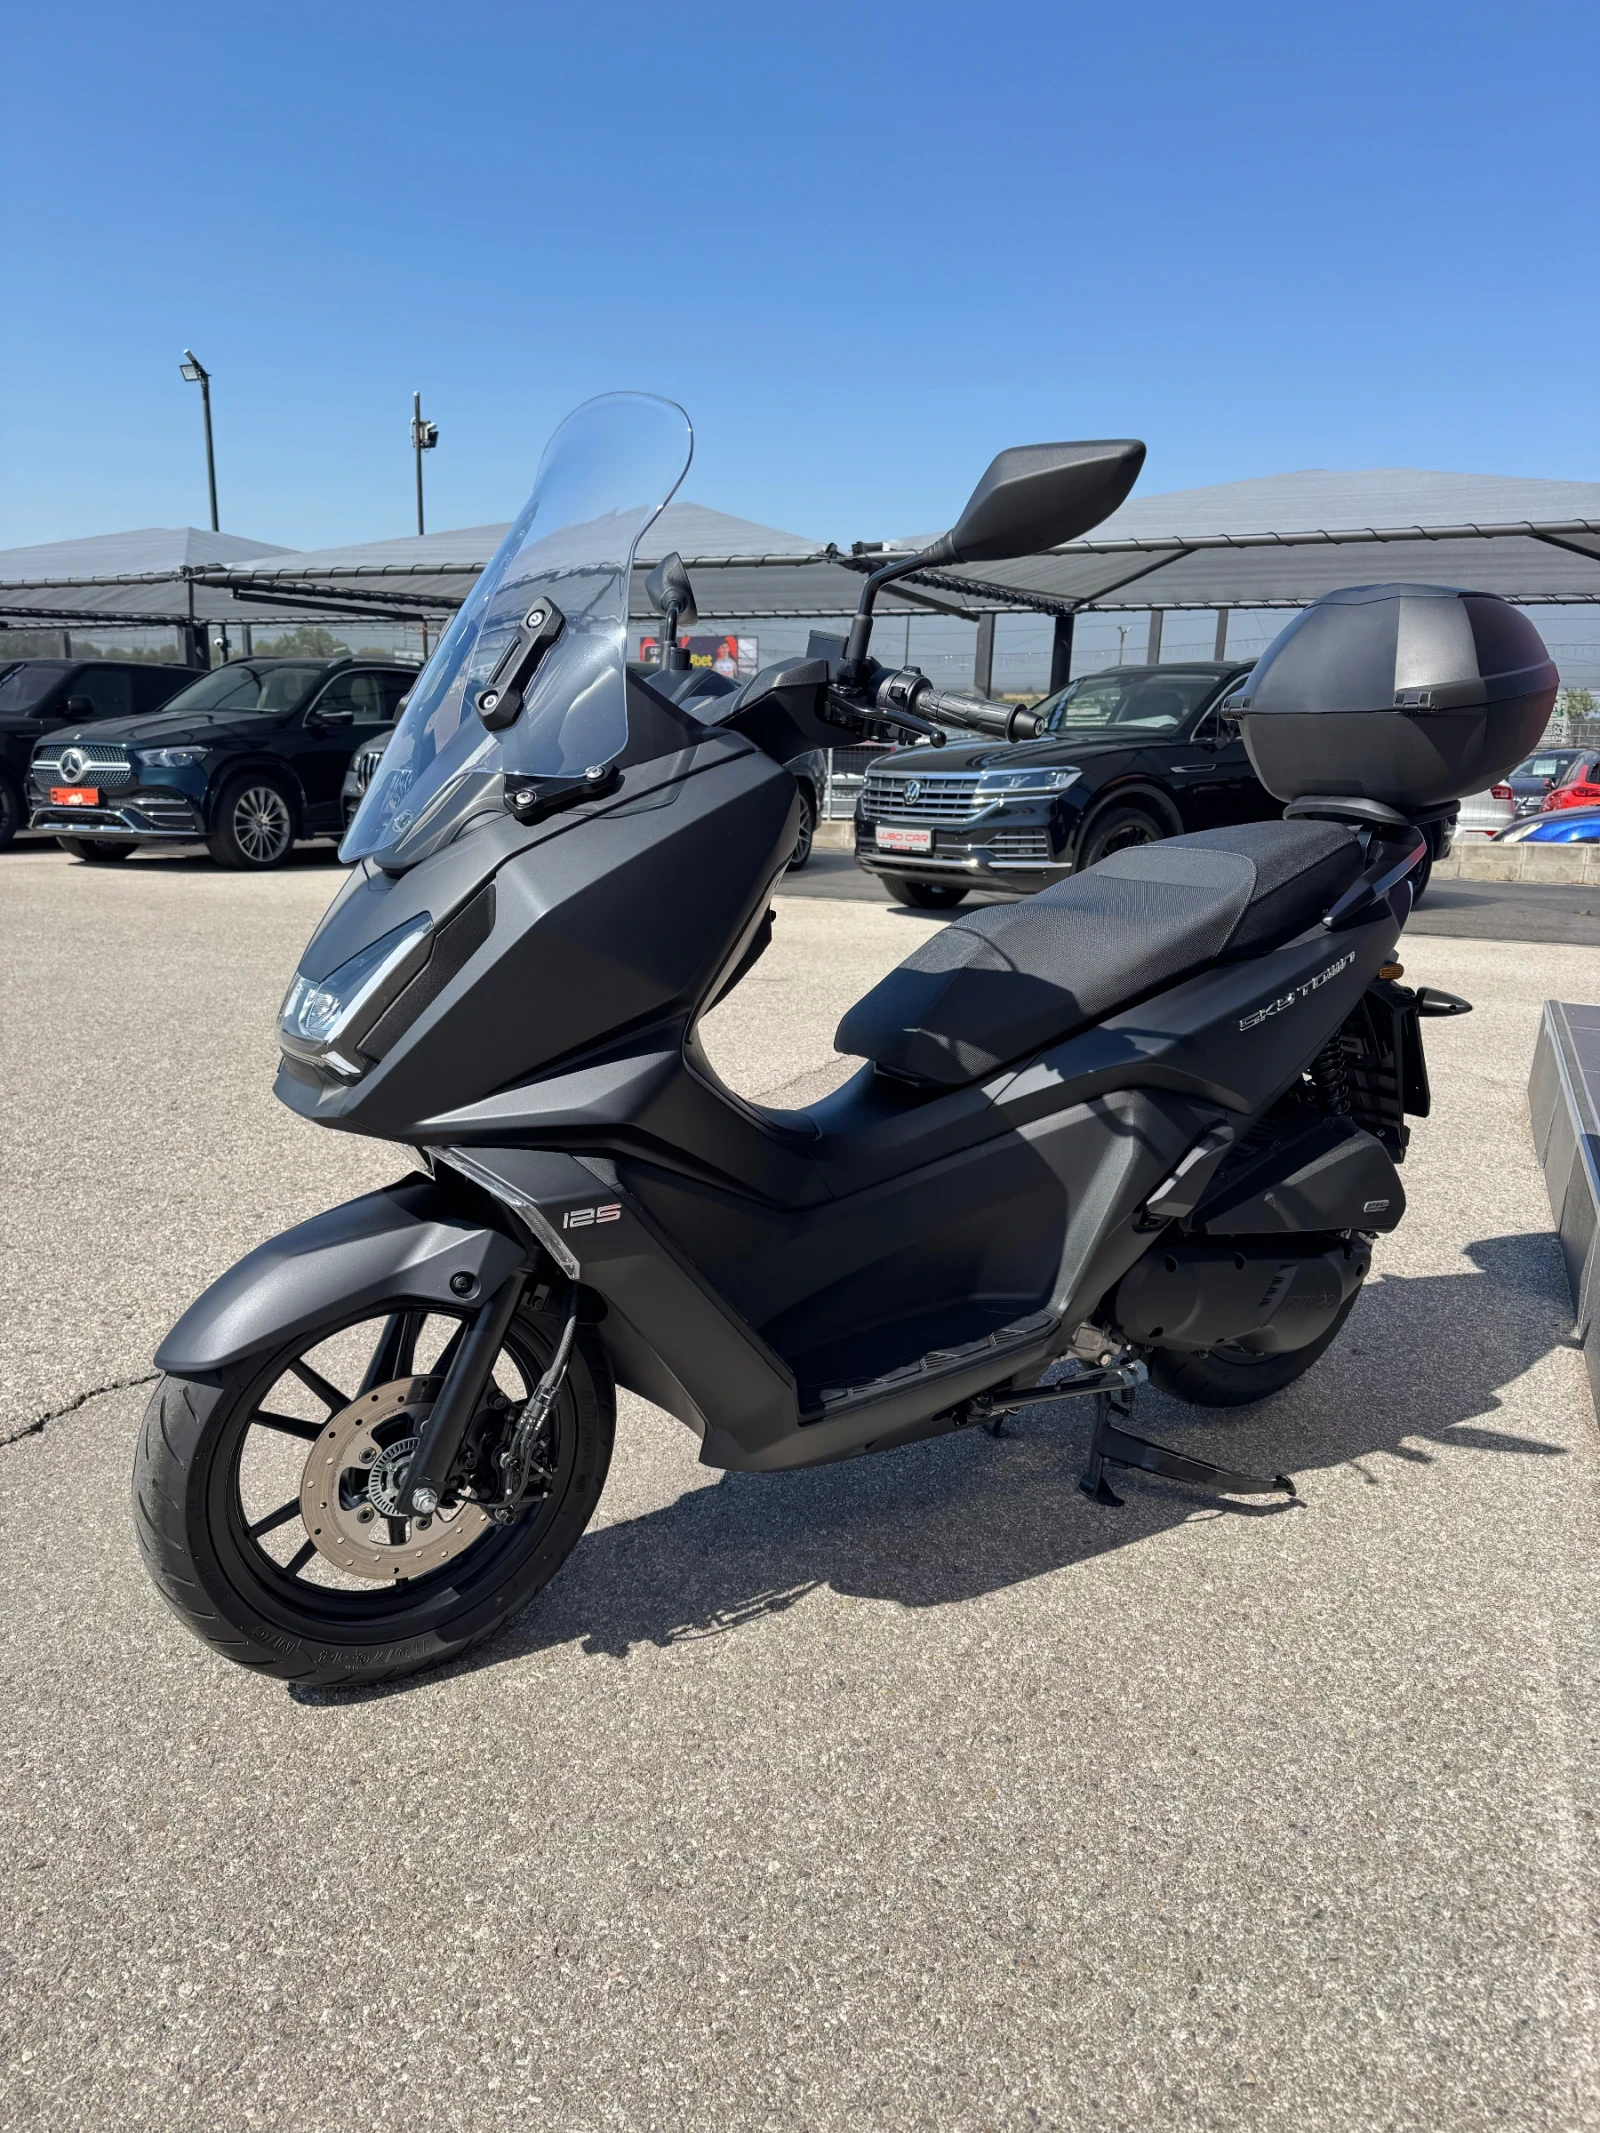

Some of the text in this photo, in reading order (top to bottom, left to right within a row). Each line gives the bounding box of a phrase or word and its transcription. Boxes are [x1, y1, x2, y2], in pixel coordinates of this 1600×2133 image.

[878, 832, 929, 842] LUBO CAR
[563, 1203, 622, 1229] 125
